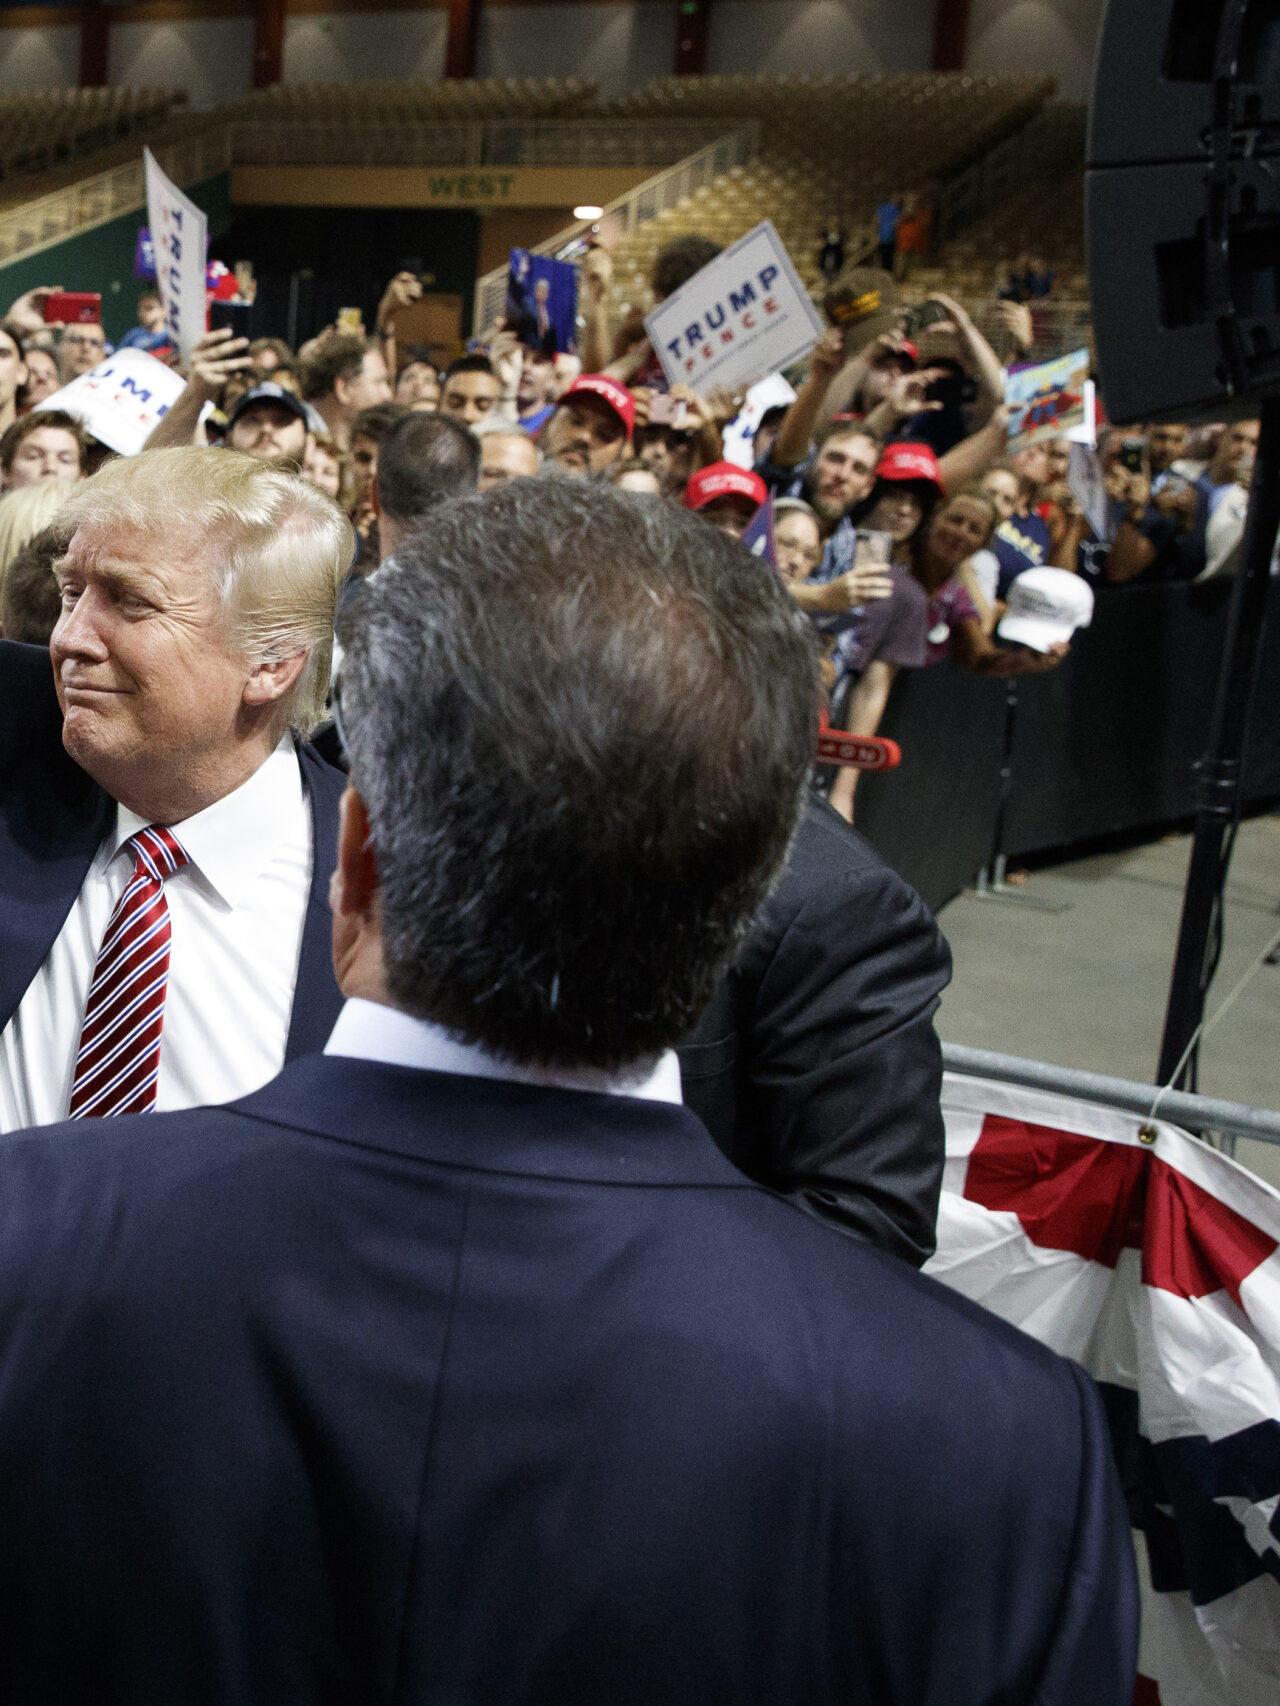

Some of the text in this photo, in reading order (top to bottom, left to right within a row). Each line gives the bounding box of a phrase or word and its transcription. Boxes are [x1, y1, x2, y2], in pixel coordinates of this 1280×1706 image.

[427, 174, 515, 198] WEST
[667, 265, 780, 360] TRUMP
[684, 297, 780, 374] PENCE
